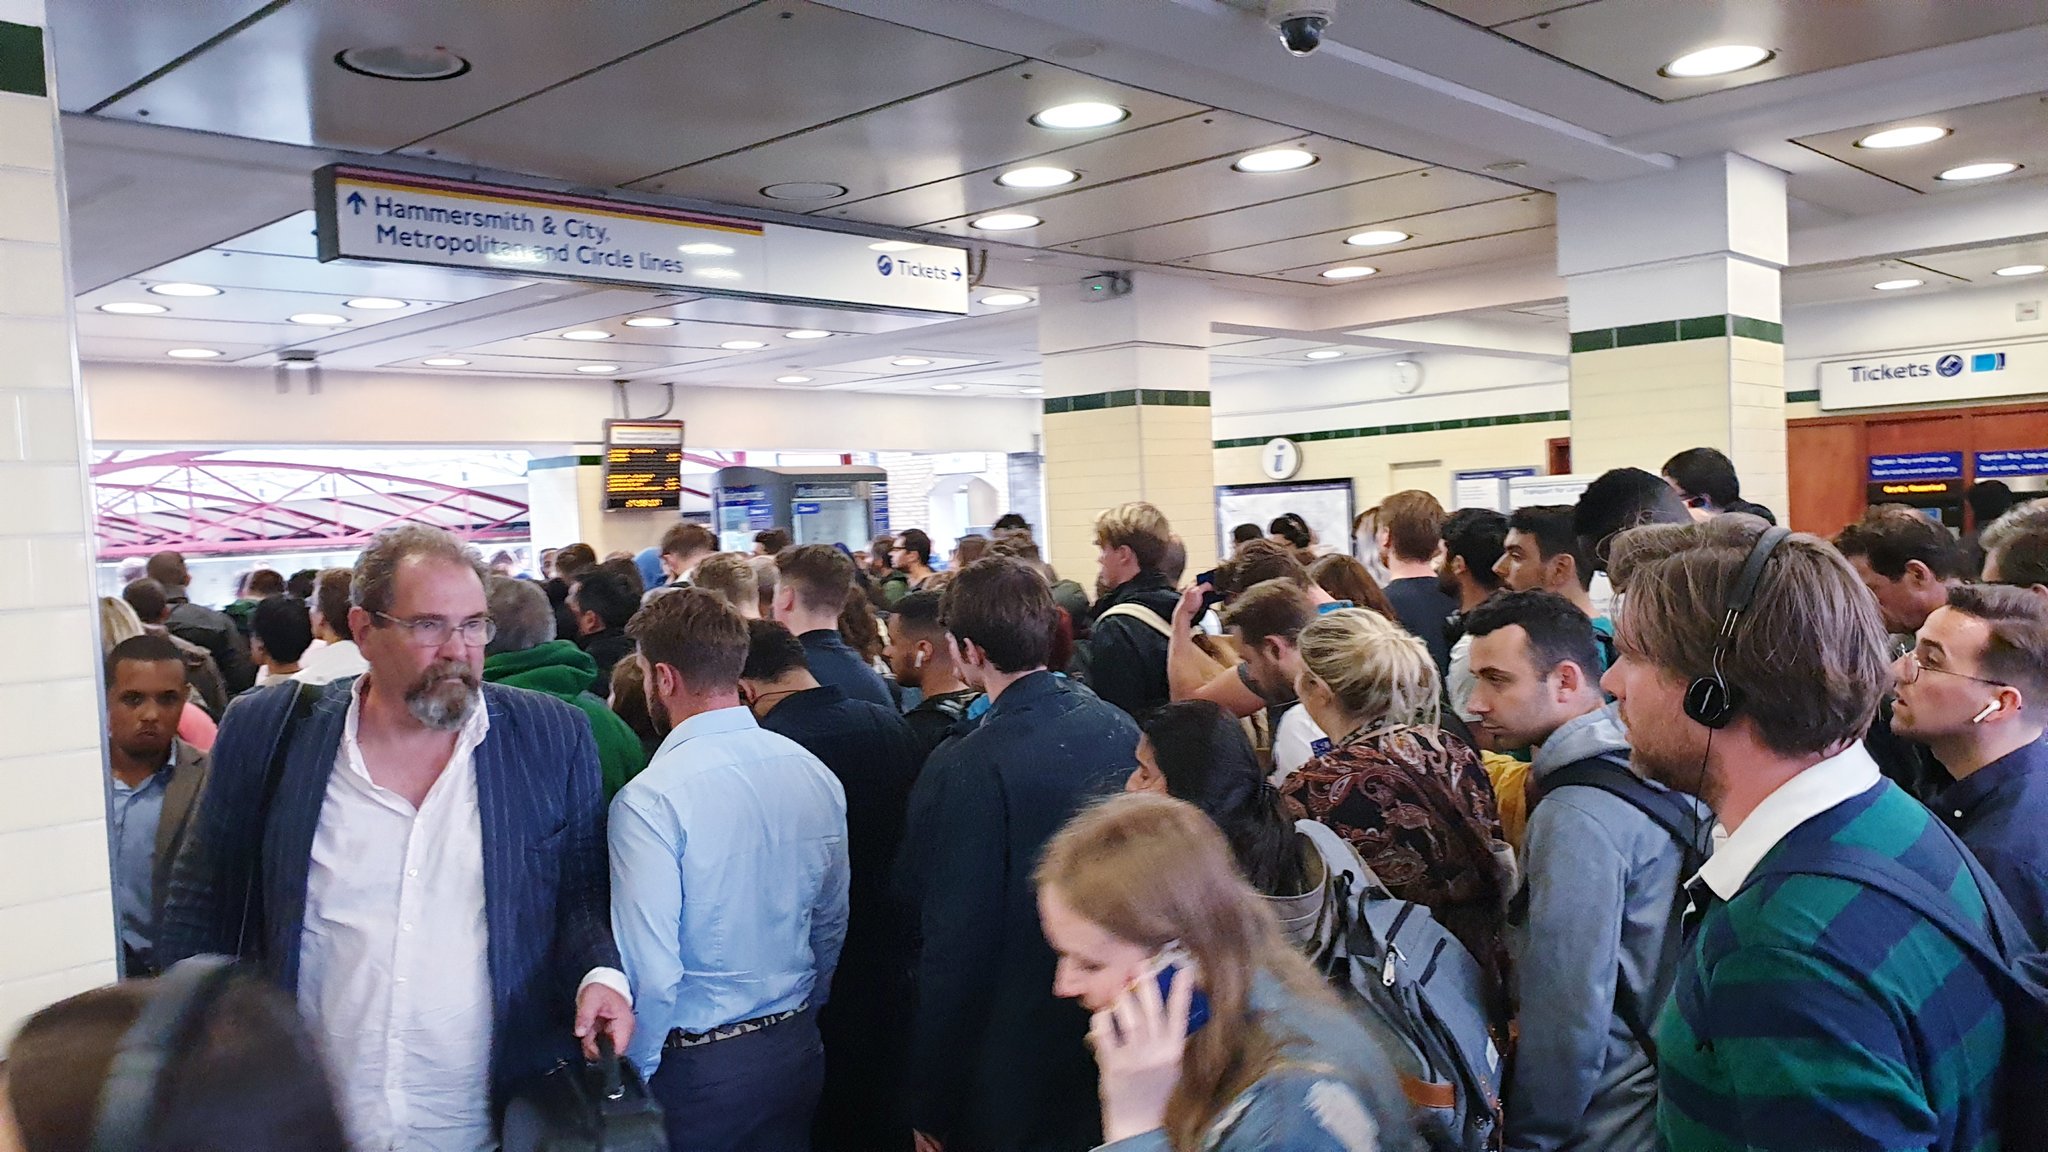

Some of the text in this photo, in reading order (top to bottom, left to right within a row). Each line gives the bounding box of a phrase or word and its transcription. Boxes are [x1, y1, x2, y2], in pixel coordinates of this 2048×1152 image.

[374, 195, 612, 245] Hammersmith & City,
[376, 223, 685, 274] Metropolitan and Circle lines
[896, 259, 948, 281] Tickets
[1847, 362, 1931, 383] Tickets
